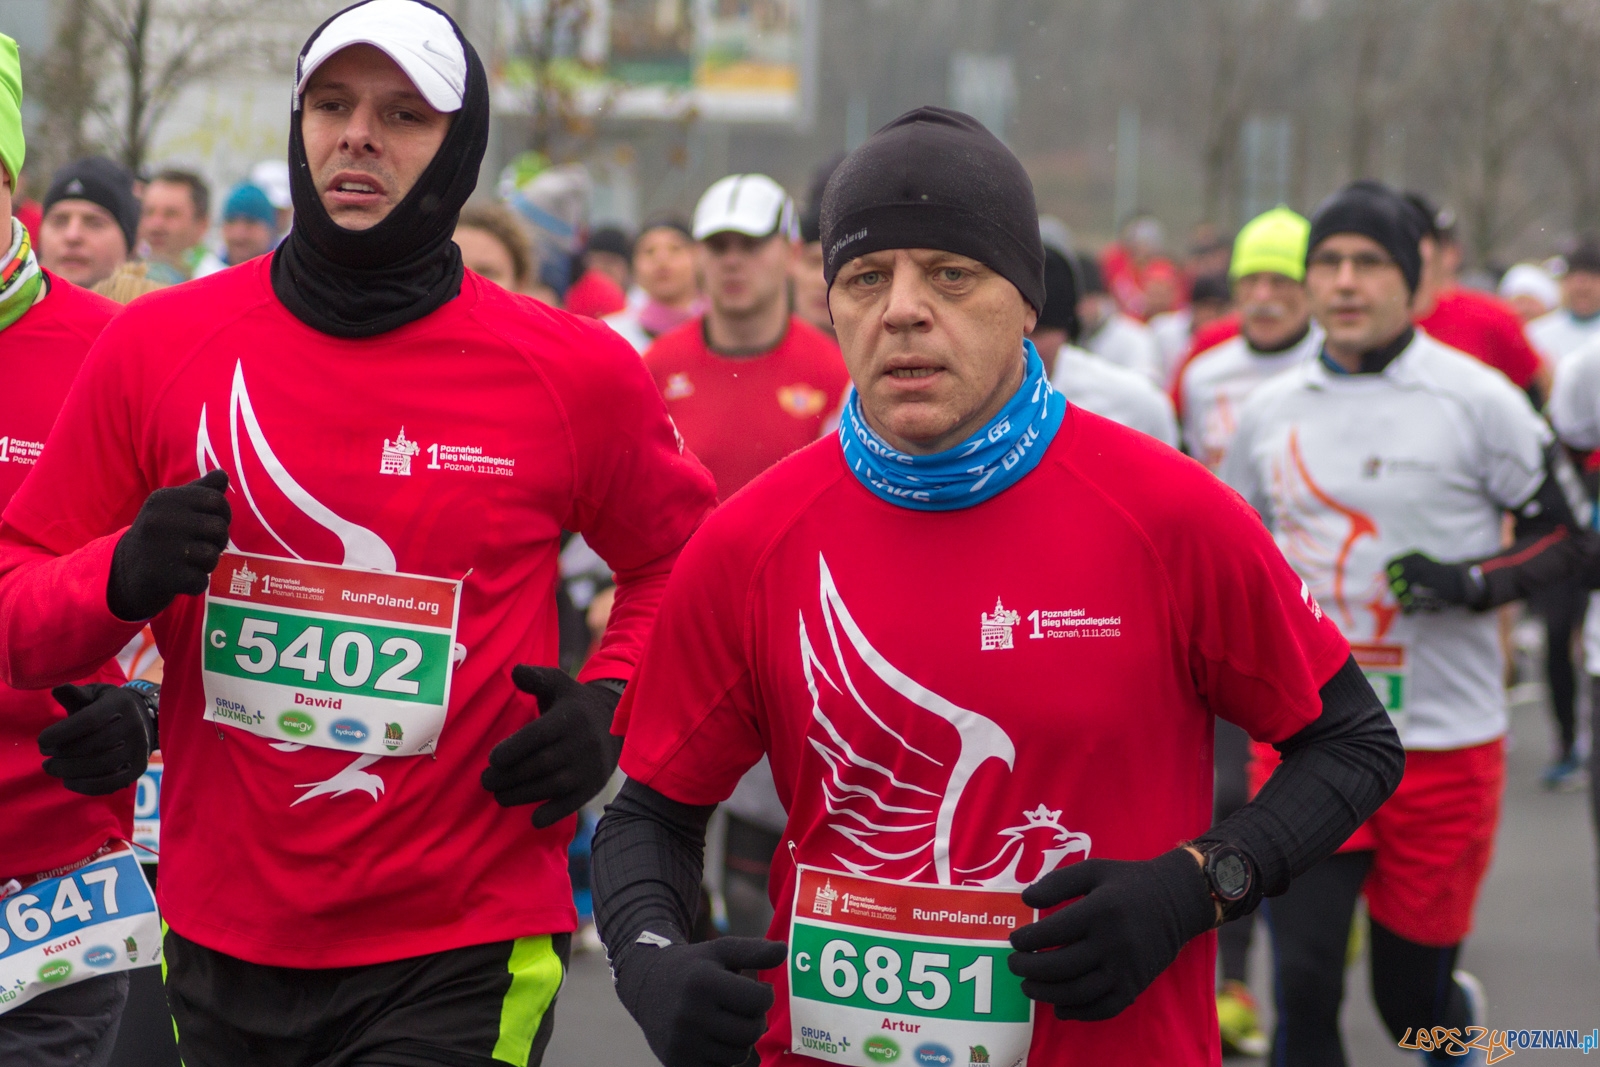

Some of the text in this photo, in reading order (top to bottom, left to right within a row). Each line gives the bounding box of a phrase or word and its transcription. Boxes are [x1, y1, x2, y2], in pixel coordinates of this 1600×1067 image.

[9, 446, 27, 456] Bieg
[427, 443, 441, 470] 1
[441, 445, 482, 454] Poznański
[440, 452, 514, 466] Bieg Niepodległości
[444, 462, 513, 476] Poznań, 11.11.2016
[261, 574, 271, 594] 1
[270, 576, 300, 585] Poznański
[270, 582, 283, 590] Bieg
[341, 589, 440, 616] RunPoland.org
[1042, 609, 1085, 617] Poznański
[1027, 610, 1044, 639] 1
[1042, 617, 1121, 627] Bieg Niepodległości
[1047, 628, 1121, 639] Poznań, 11.11.2016
[234, 616, 424, 695] 5402
[216, 697, 246, 714] GRUPA
[294, 693, 342, 710] Dawid
[216, 707, 252, 725] LUXMED
[283, 720, 312, 732] energy
[841, 892, 849, 913] 1
[849, 894, 875, 904] Poznański
[849, 899, 860, 907] Bieg
[912, 908, 1016, 929] RunPoland.org
[43, 936, 82, 957] Karol
[43, 965, 70, 978] energy
[819, 938, 994, 1014] 6851
[881, 1017, 921, 1034] Artur
[801, 1026, 832, 1042] GRUPA
[802, 1037, 837, 1054] LUXMED
[868, 1046, 898, 1059] energy
